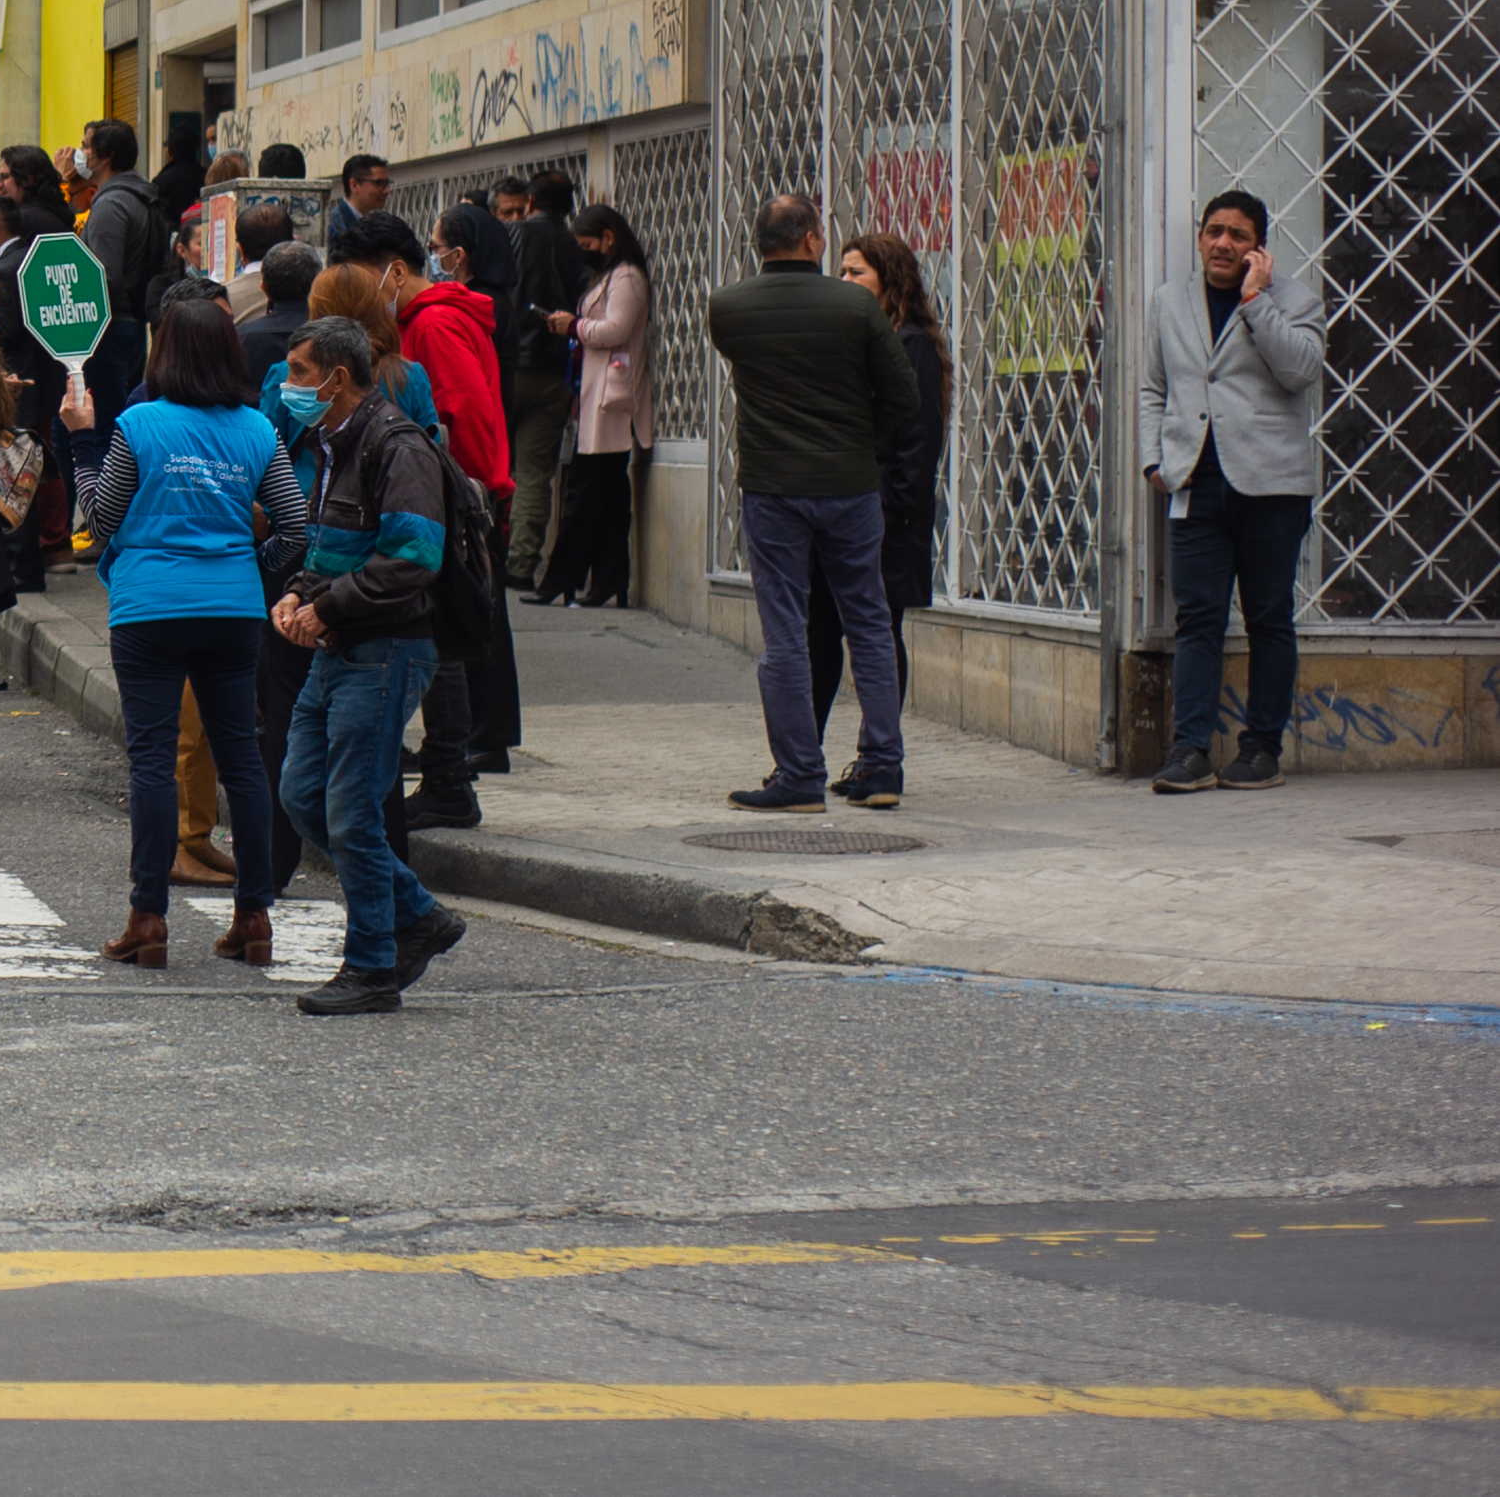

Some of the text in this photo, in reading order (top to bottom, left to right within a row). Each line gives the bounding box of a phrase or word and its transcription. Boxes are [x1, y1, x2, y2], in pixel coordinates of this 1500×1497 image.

[44, 263, 78, 286] PUNTO
[59, 283, 73, 305] DE
[39, 301, 98, 327] ENCUENTRO
